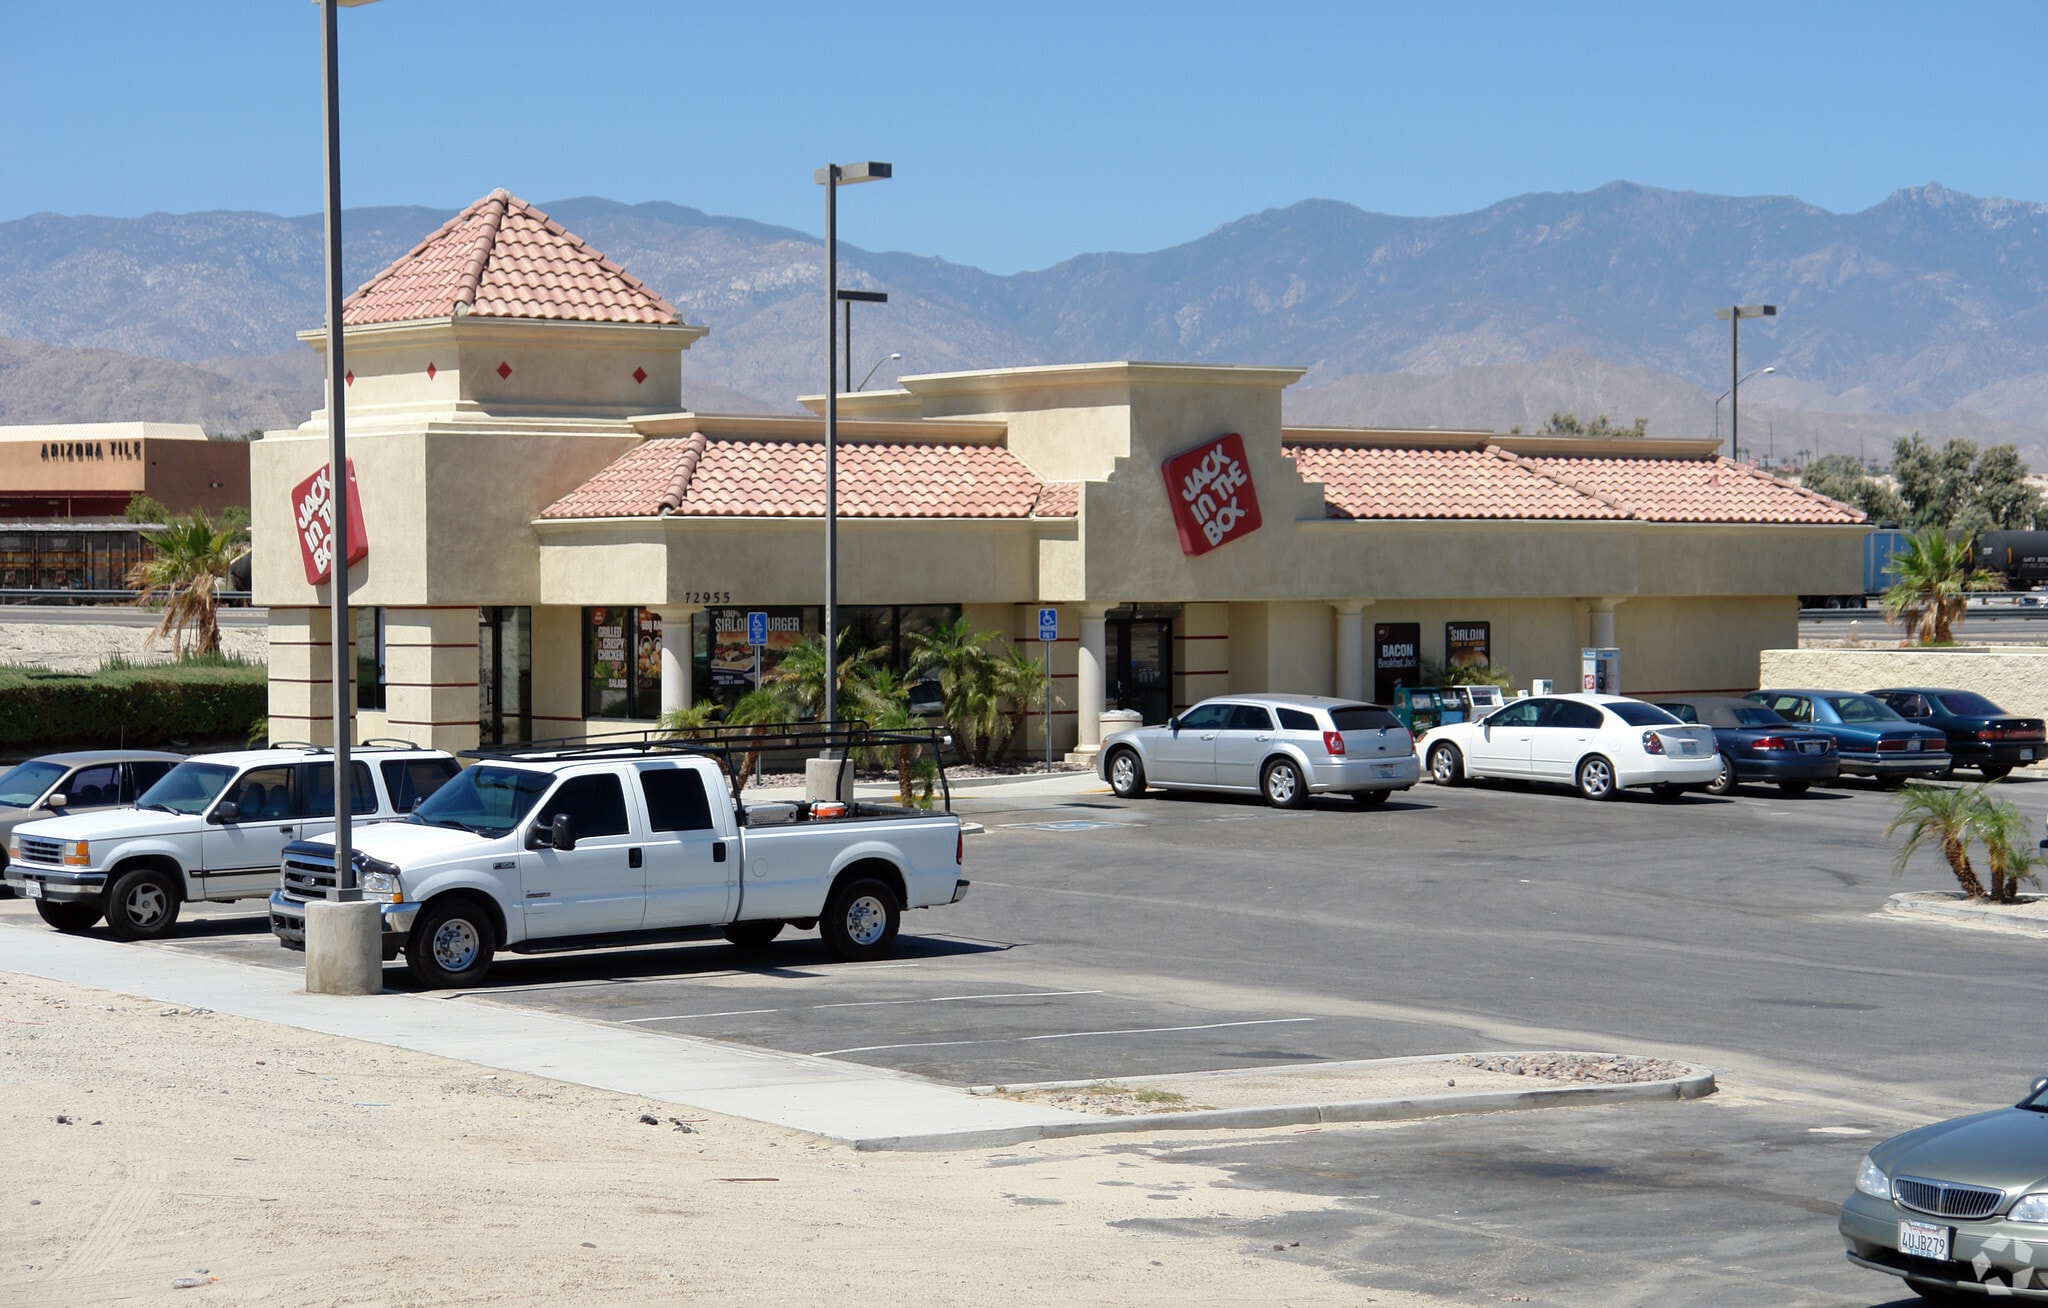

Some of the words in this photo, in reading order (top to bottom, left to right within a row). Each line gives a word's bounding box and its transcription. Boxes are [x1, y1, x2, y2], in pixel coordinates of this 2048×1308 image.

[41, 442, 104, 462] ARIZONA
[109, 440, 142, 461] TILE
[1182, 443, 1230, 501] JACK
[298, 468, 331, 529] JACK
[1190, 493, 1217, 525] IN
[1211, 460, 1248, 501] THE
[1203, 495, 1246, 547] BOX
[304, 520, 324, 553] IN
[313, 533, 332, 574] BO
[684, 591, 730, 604] 72955
[597, 626, 622, 638] GRILLED
[715, 617, 748, 632] SIRLOI
[767, 616, 800, 632] URGER
[1451, 628, 1485, 641] SIRLOIN
[602, 637, 625, 649] CRISPY
[1382, 643, 1414, 658] BACON
[597, 648, 624, 661] CHICKEN
[1378, 657, 1403, 669] Breakfast
[608, 678, 627, 688] SALADS
[1902, 1232, 1945, 1254] 4UJB279
